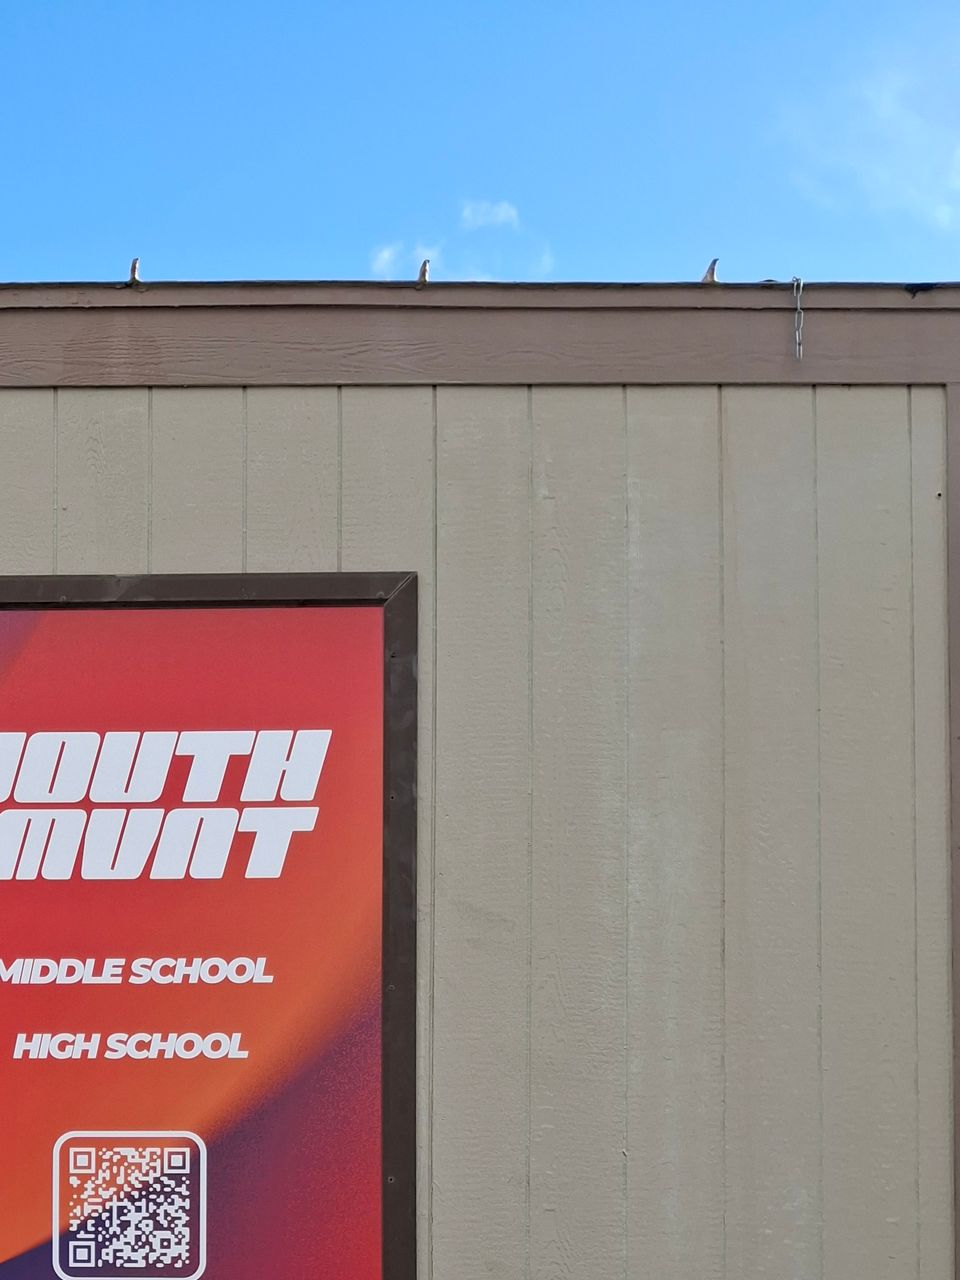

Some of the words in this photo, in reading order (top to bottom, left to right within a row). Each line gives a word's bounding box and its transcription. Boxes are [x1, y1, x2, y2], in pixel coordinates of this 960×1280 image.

[128, 956, 274, 984] SCHOOL
[12, 1032, 101, 1060] HIGH
[103, 1032, 249, 1059] SCHOOL
